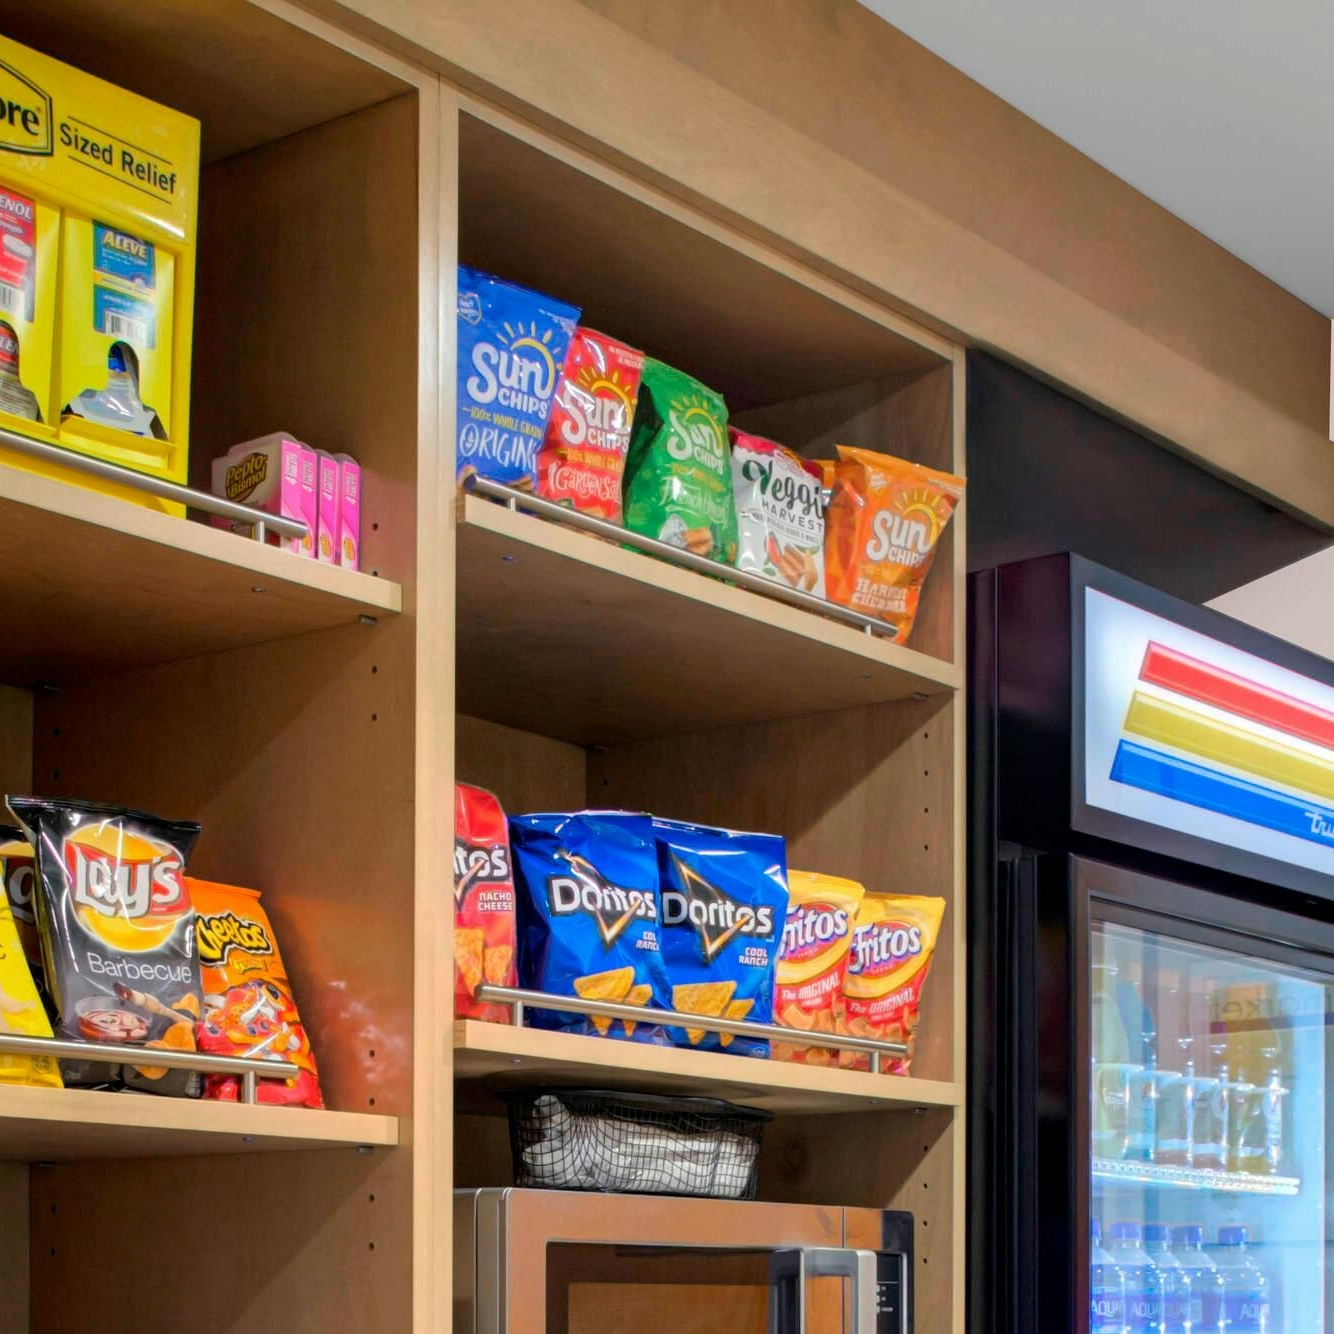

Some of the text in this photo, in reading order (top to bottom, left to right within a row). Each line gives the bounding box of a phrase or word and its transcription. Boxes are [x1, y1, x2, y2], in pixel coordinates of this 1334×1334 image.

[59, 122, 177, 194] Sized Relief
[102, 228, 148, 258] ALEVE
[467, 341, 554, 405] Sun
[497, 387, 548, 420] CHIPS
[561, 383, 633, 446] Sun
[586, 428, 630, 454] CHIPS
[666, 409, 724, 461] Sun
[226, 454, 268, 482] Pepto-
[693, 446, 724, 476] CHIPS
[741, 460, 823, 519] Veggi
[762, 499, 823, 534] HARVEST
[865, 509, 932, 562] Sun
[888, 546, 926, 569] CHIPS
[74, 845, 184, 919] Lay's
[478, 892, 512, 902] NACHO
[551, 876, 657, 919] Doritos
[477, 902, 514, 912] CHEESE
[662, 891, 773, 934] Doritos
[196, 913, 270, 965] Cheetos
[745, 946, 768, 957] COOL
[848, 923, 922, 975] Fritos
[86, 950, 194, 985] Barbecue
[738, 955, 769, 967] RANCH
[798, 972, 841, 998] ORIGINAL
[868, 988, 915, 1014] ORIGINAL
